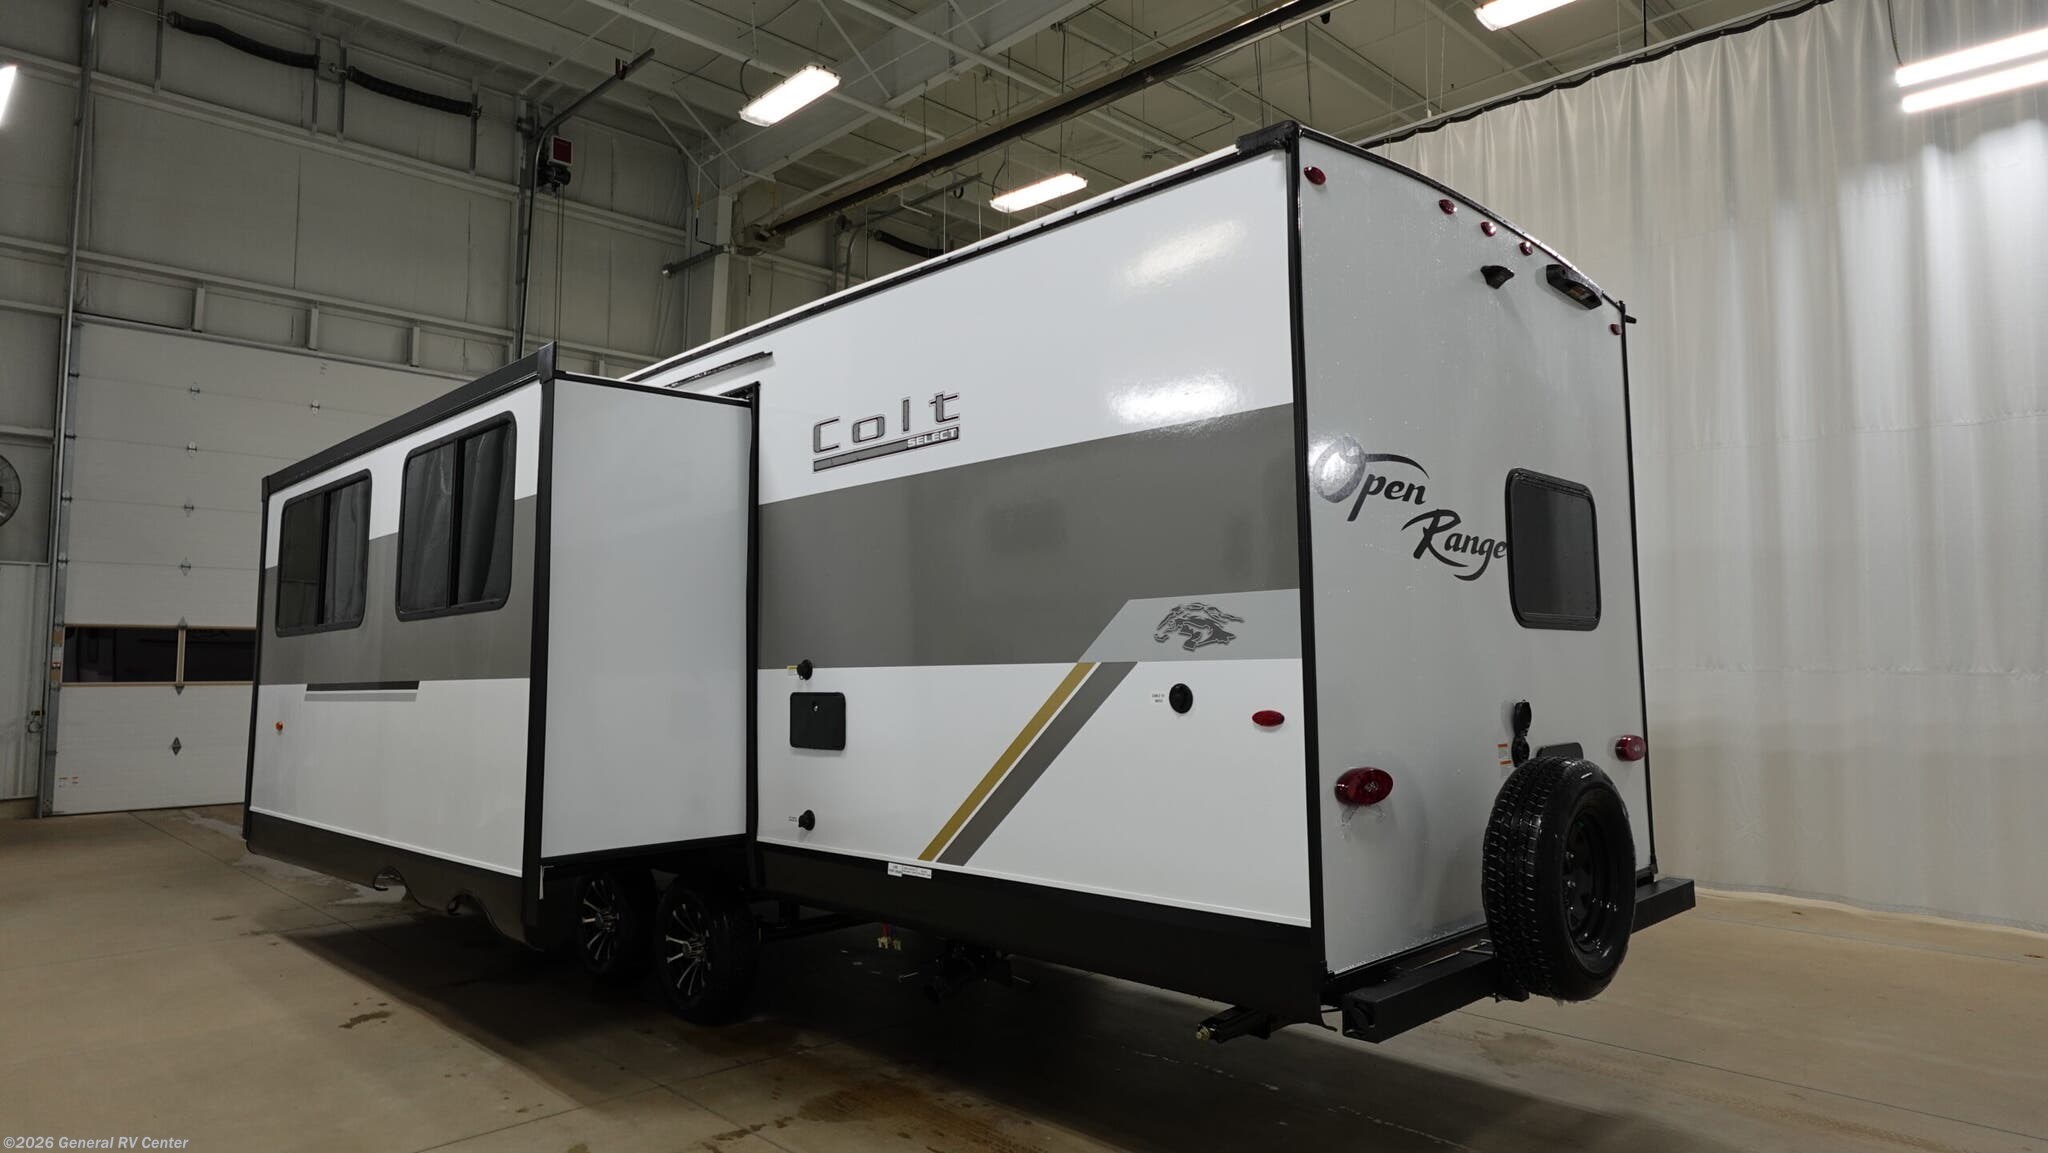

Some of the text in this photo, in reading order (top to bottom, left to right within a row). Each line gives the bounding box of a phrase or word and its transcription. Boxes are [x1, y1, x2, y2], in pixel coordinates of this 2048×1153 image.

[813, 393, 960, 453] Colt
[906, 428, 958, 449] SELECT
[1313, 436, 1430, 522] Open
[1401, 508, 1507, 581] Range
